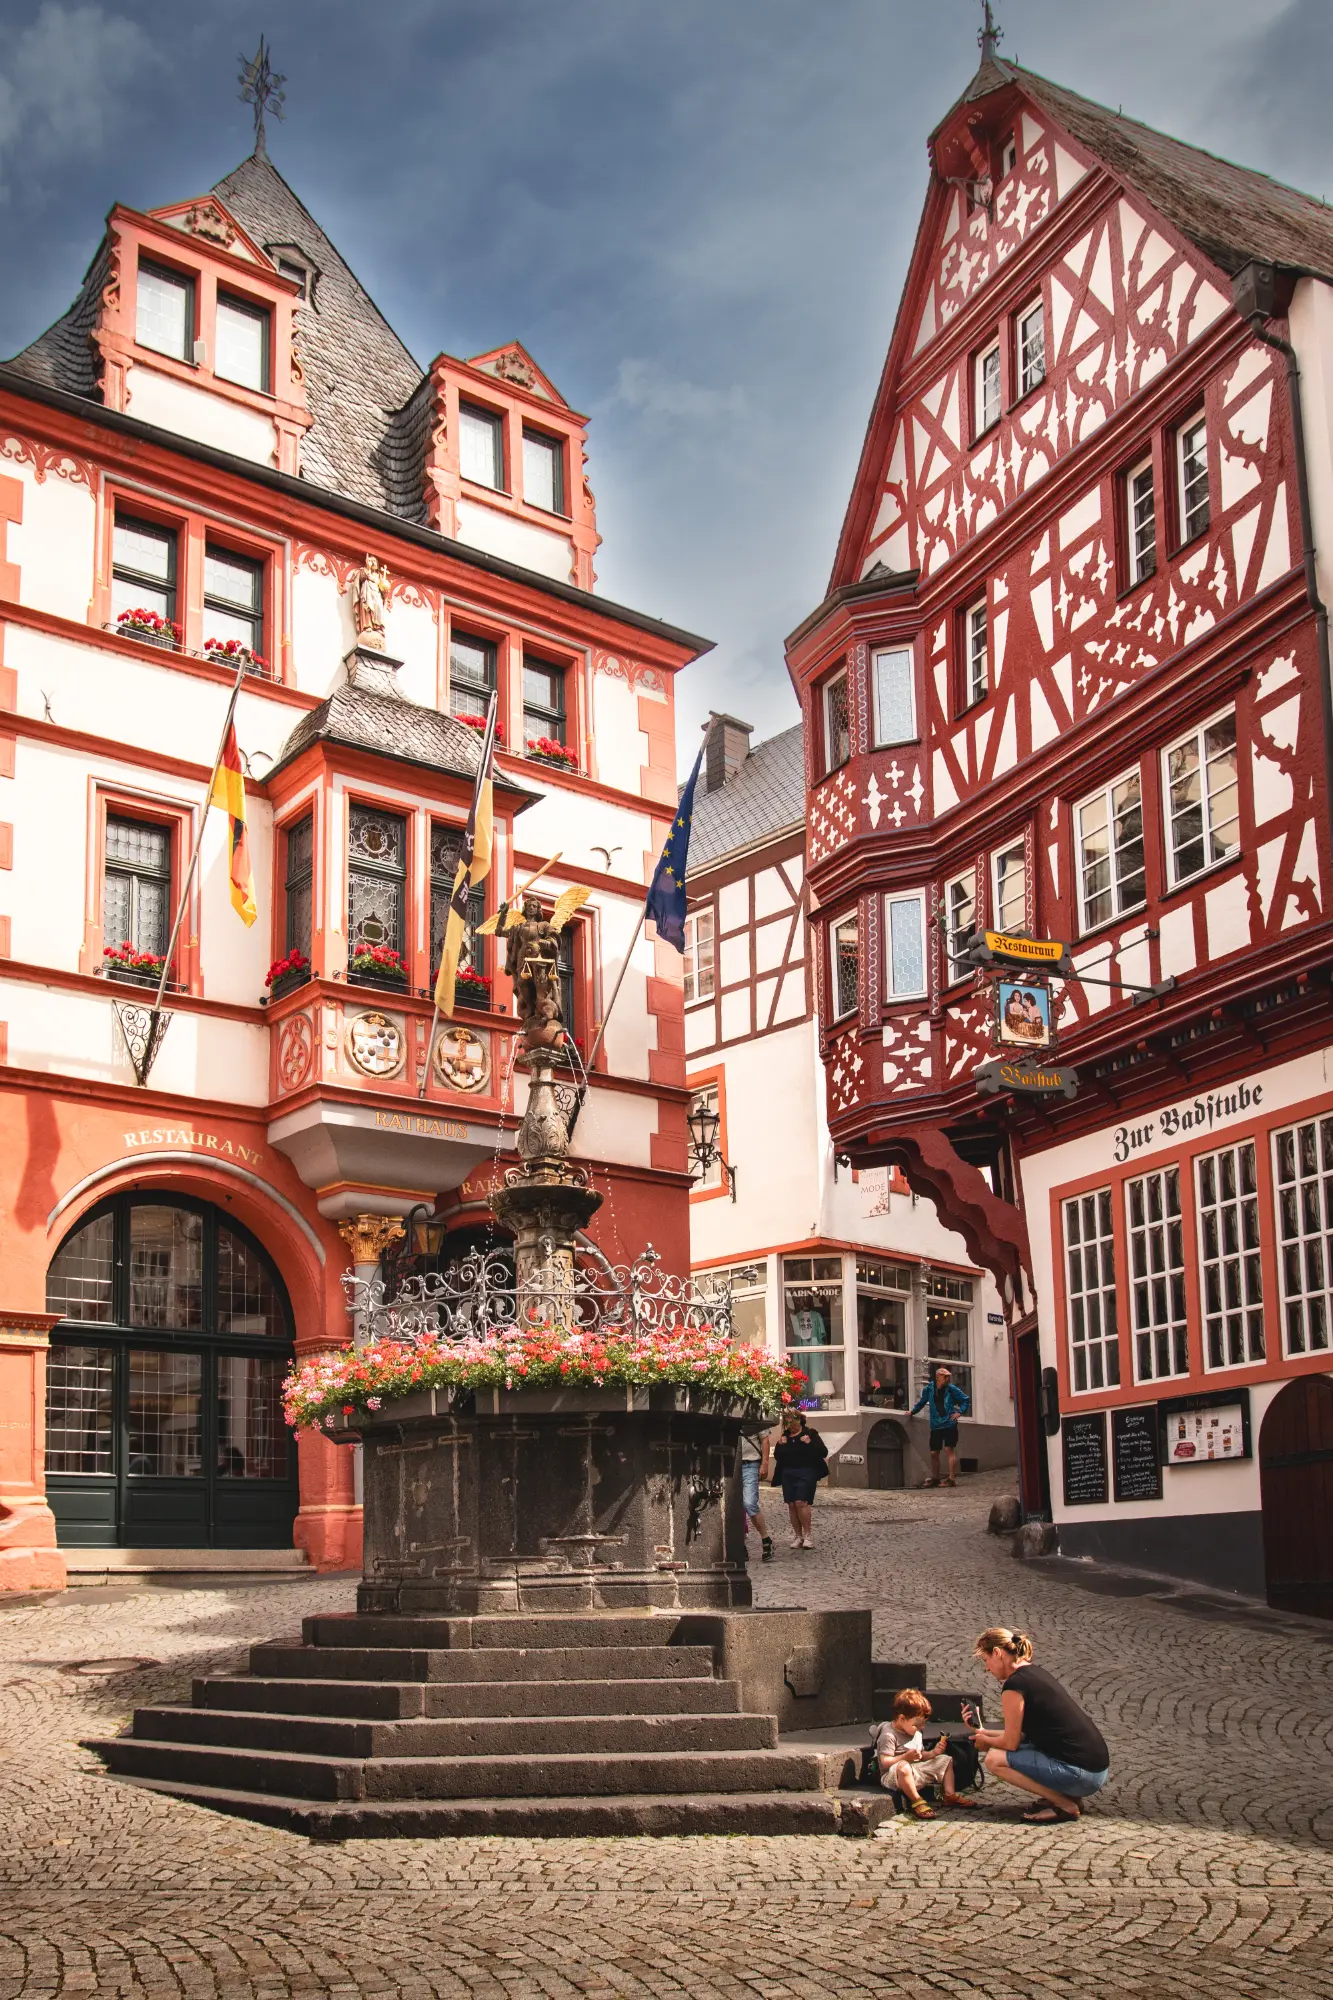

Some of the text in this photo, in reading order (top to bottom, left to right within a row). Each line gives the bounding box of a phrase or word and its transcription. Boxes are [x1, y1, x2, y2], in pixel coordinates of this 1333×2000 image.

[994, 936, 1055, 957] Restaurant
[375, 1111, 468, 1139] RATHAUS
[123, 1129, 263, 1166] RESTAURANT
[1113, 1123, 1154, 1162] Zur
[861, 1182, 886, 1193] MODE
